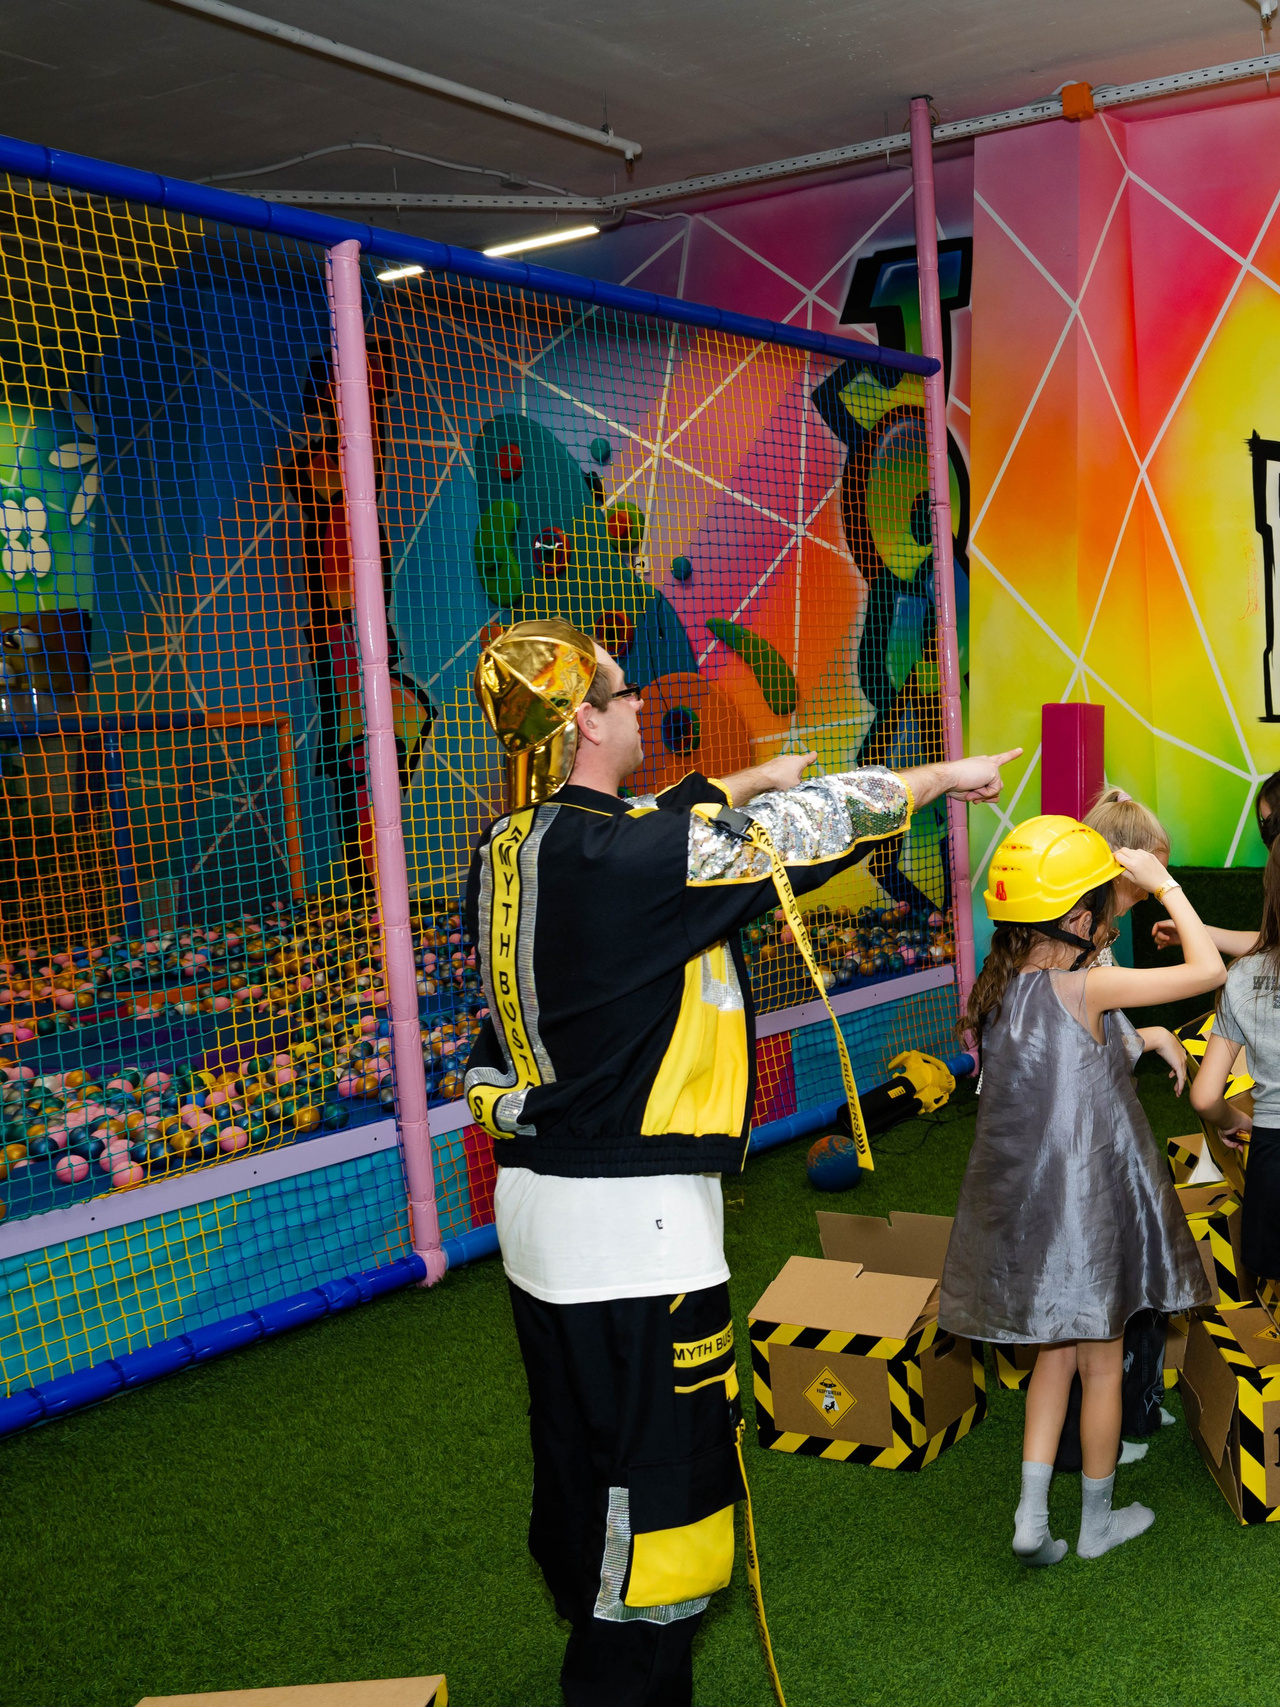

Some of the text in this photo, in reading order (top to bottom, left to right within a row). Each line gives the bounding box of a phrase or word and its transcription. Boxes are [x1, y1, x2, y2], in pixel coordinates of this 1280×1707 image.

[498, 843, 514, 958] MYTH
[762, 837, 810, 950] MTH BUSTERS
[842, 1063, 861, 1131] BUSTERS
[674, 1342, 713, 1361] MYTH
